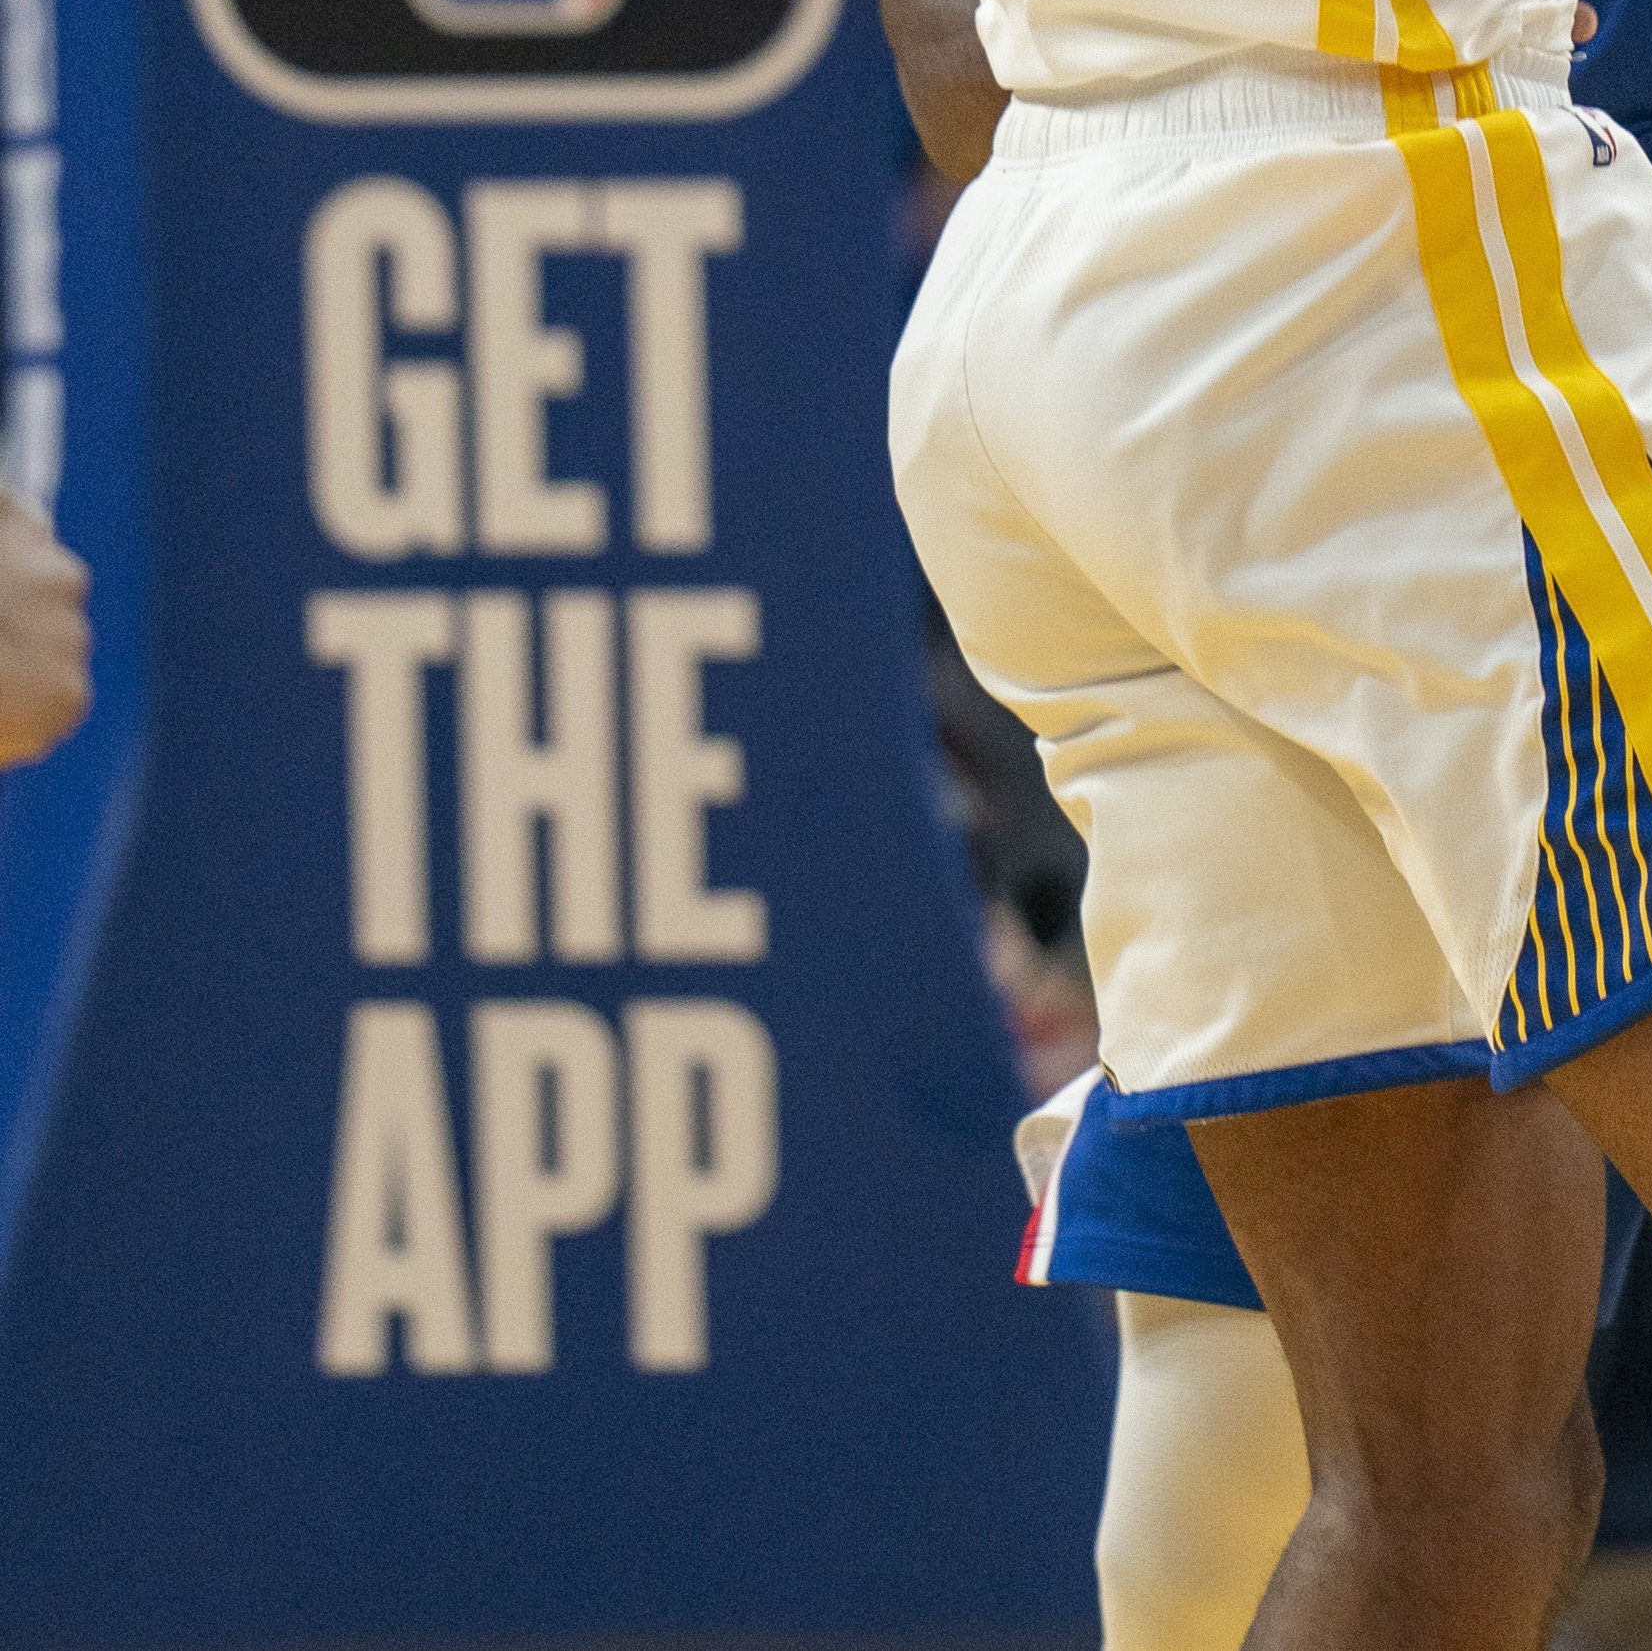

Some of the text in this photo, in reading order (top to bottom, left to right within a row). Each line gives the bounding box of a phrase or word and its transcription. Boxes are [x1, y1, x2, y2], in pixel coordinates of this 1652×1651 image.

[302, 174, 744, 560] GET
[303, 588, 768, 964] THE
[315, 999, 781, 1376] APP
